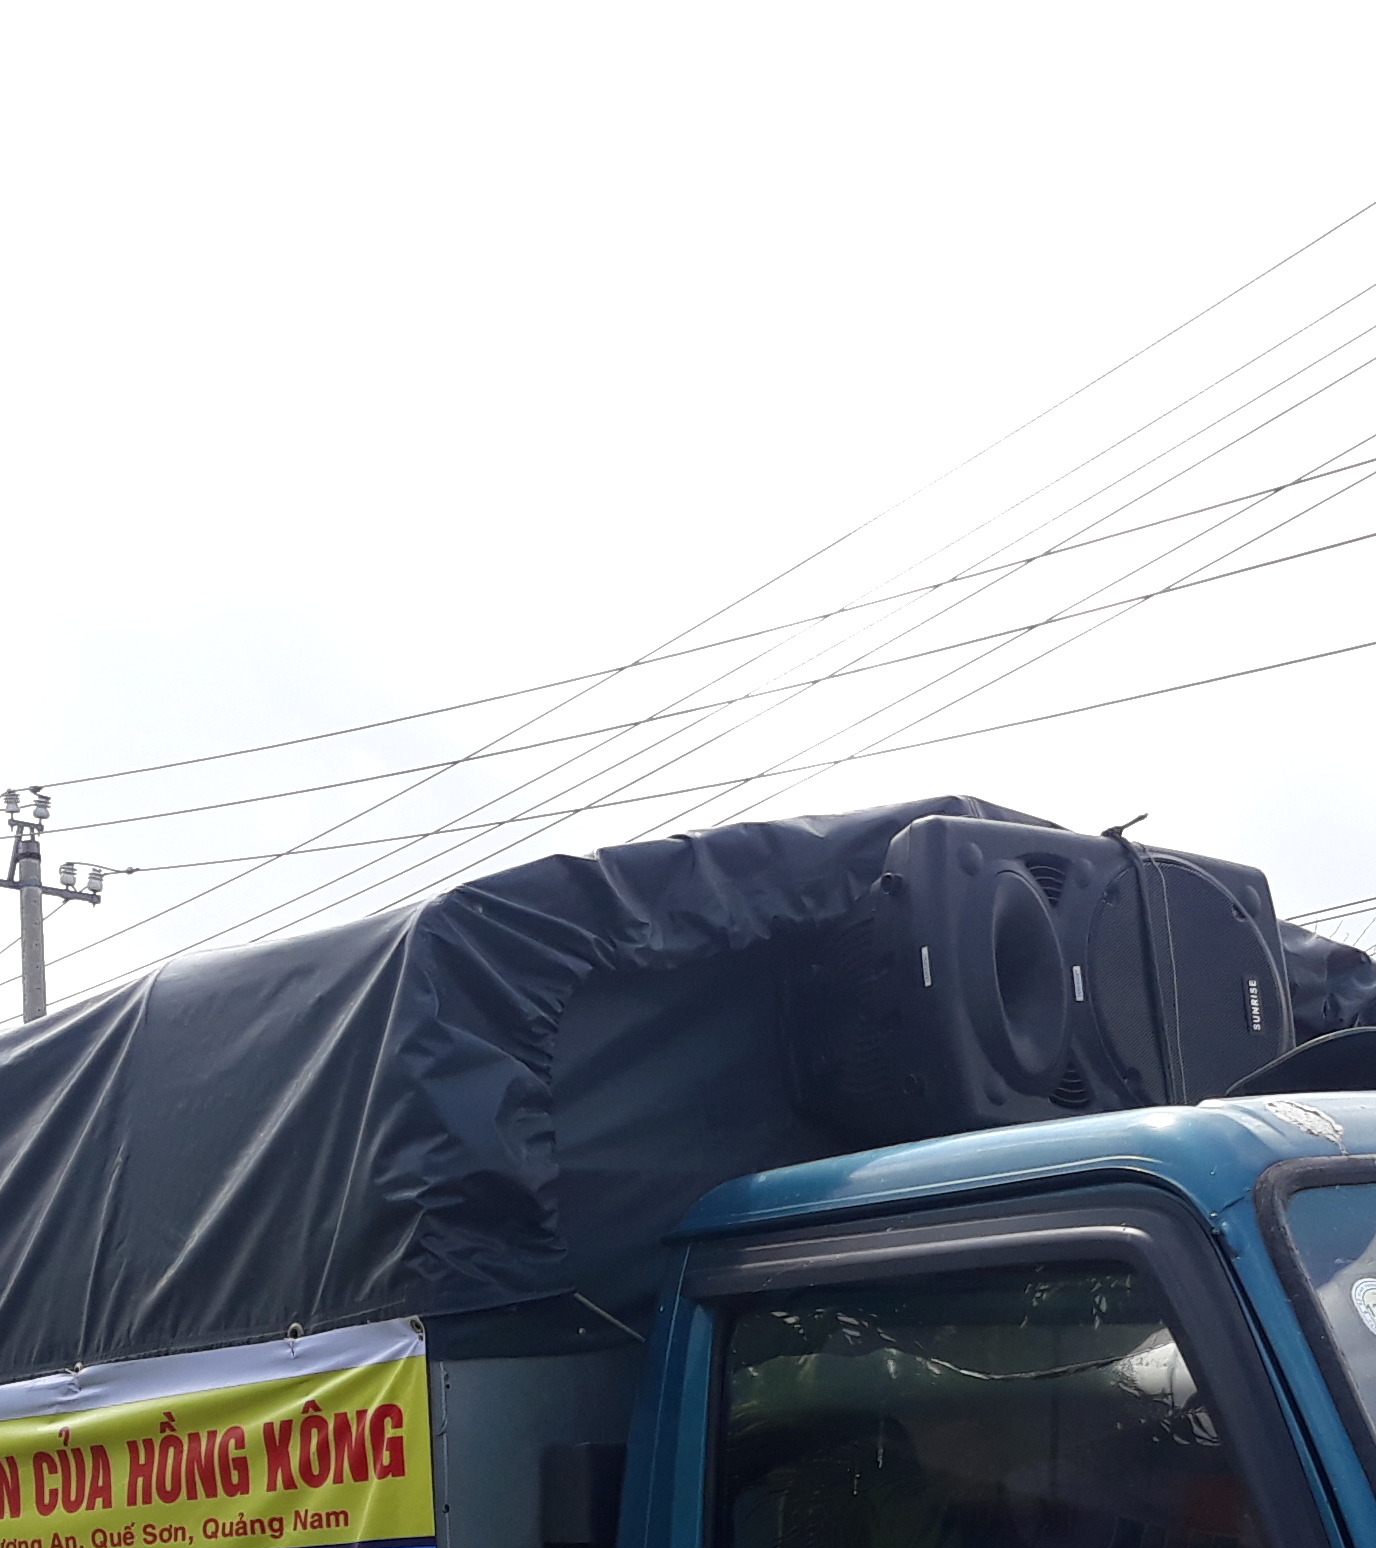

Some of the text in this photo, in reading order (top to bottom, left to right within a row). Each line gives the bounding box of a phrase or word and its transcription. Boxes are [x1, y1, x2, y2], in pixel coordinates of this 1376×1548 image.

[1248, 979, 1261, 1031] SUNRISE
[33, 1426, 112, 1516] CỦA
[126, 1411, 250, 1507] HỒNG
[263, 1400, 405, 1492] KÔNG
[91, 1522, 136, 1548] Quế
[143, 1524, 194, 1545] Sơn,
[202, 1512, 284, 1540] Quảng
[293, 1509, 350, 1532] Nam
